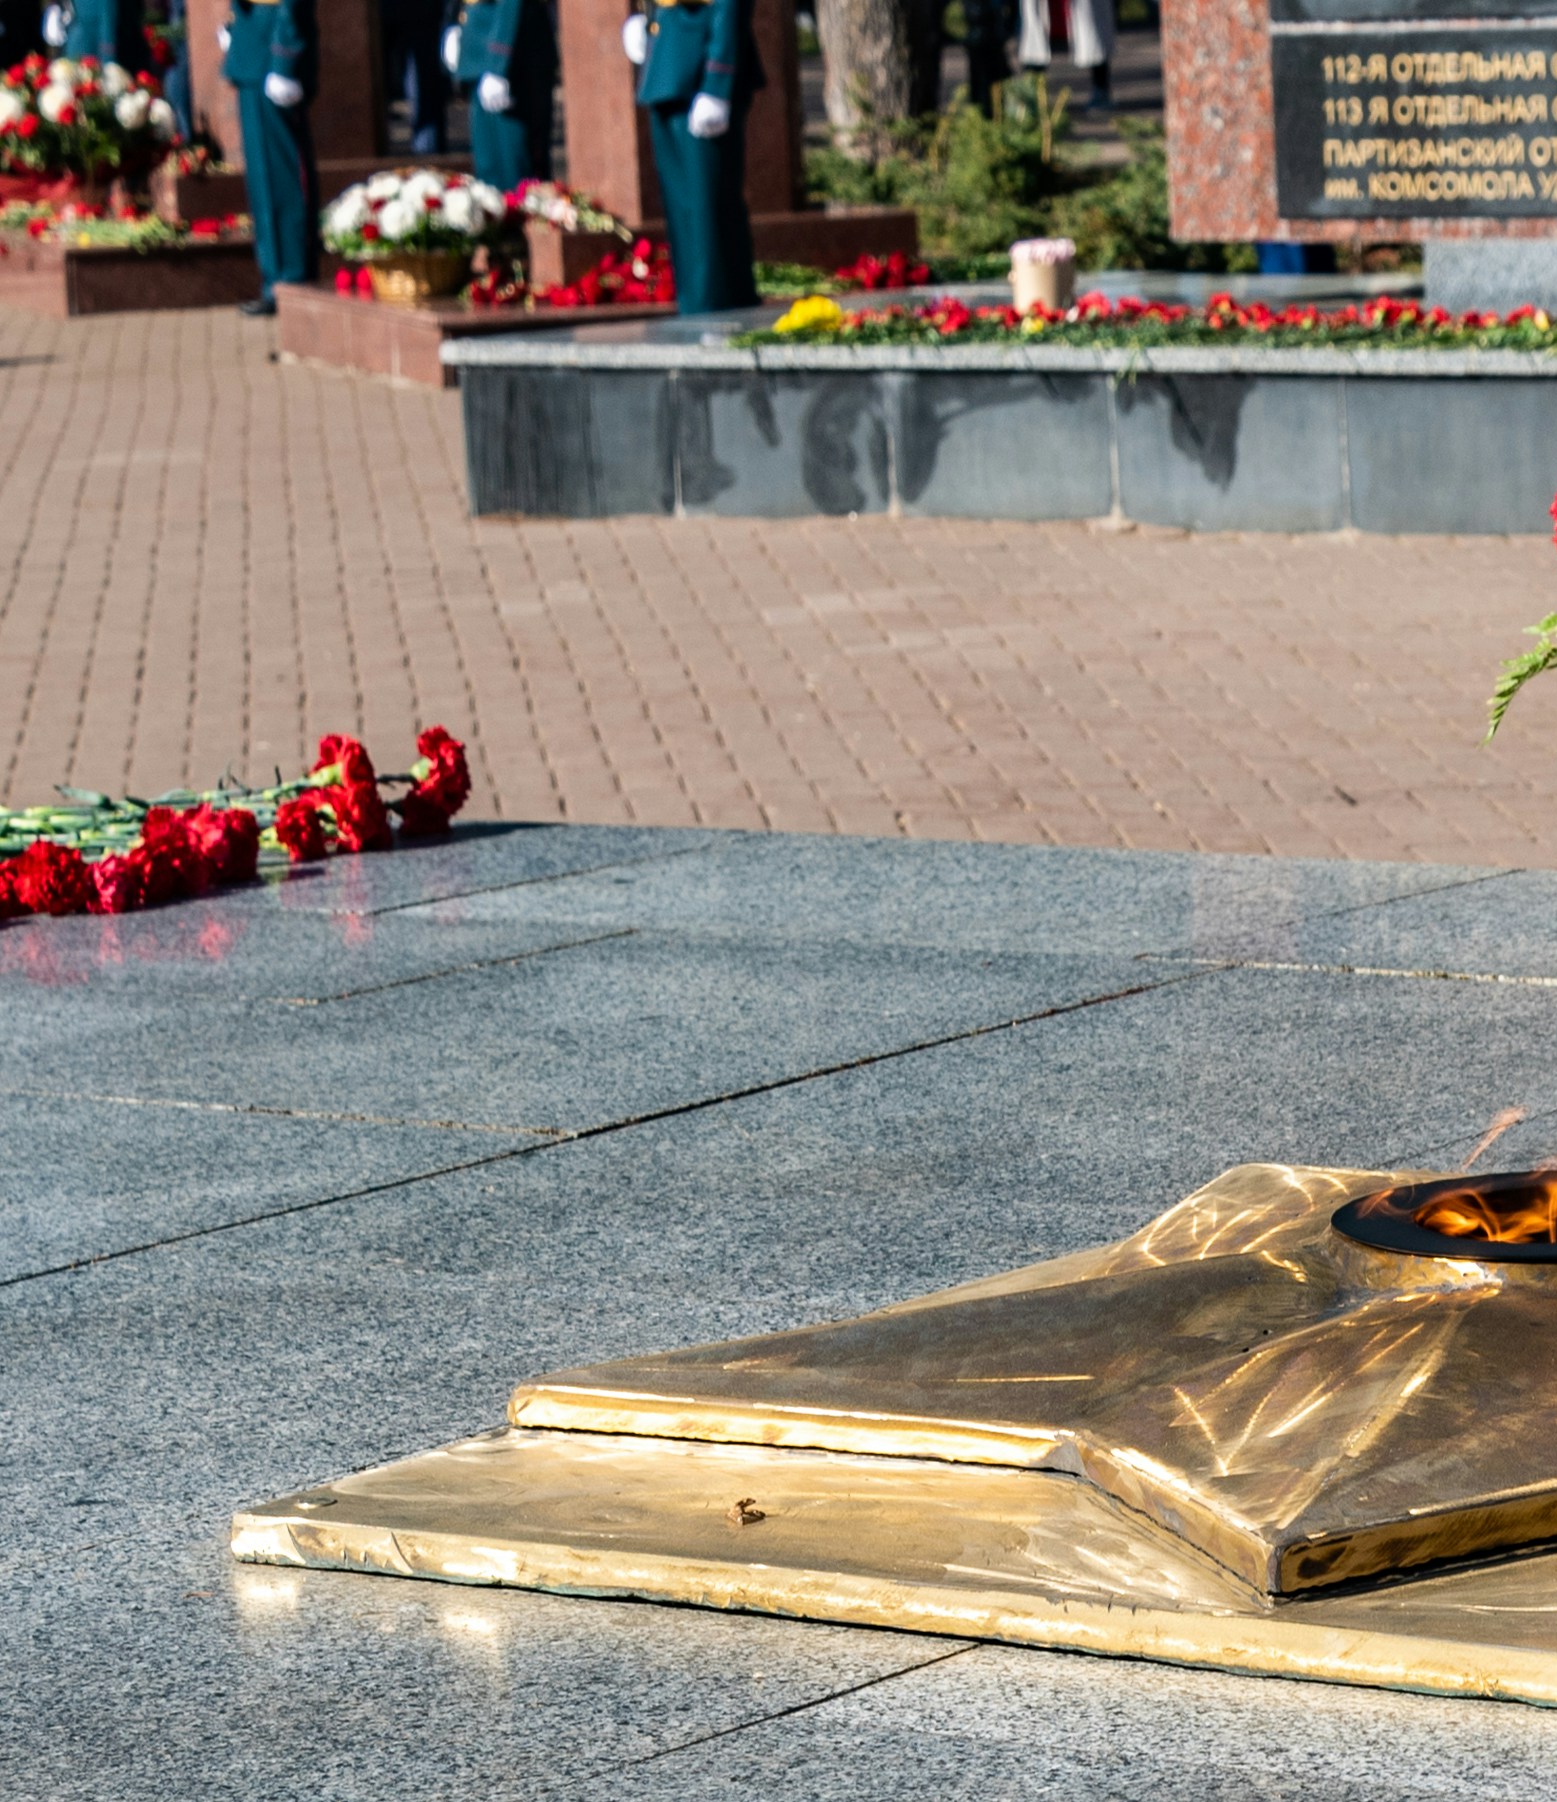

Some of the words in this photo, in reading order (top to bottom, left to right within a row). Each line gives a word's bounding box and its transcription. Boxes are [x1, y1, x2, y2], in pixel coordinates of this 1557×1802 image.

[1321, 53, 1388, 84] 112-Я
[1391, 50, 1546, 85] ОТДЕЛЬНАЯ
[1392, 94, 1548, 128] ОТДЕЛЬНАЯ
[1323, 132, 1525, 168] ПАРТИЗАНСКИЙ
[1367, 170, 1535, 201] КОМСОМОЛА
